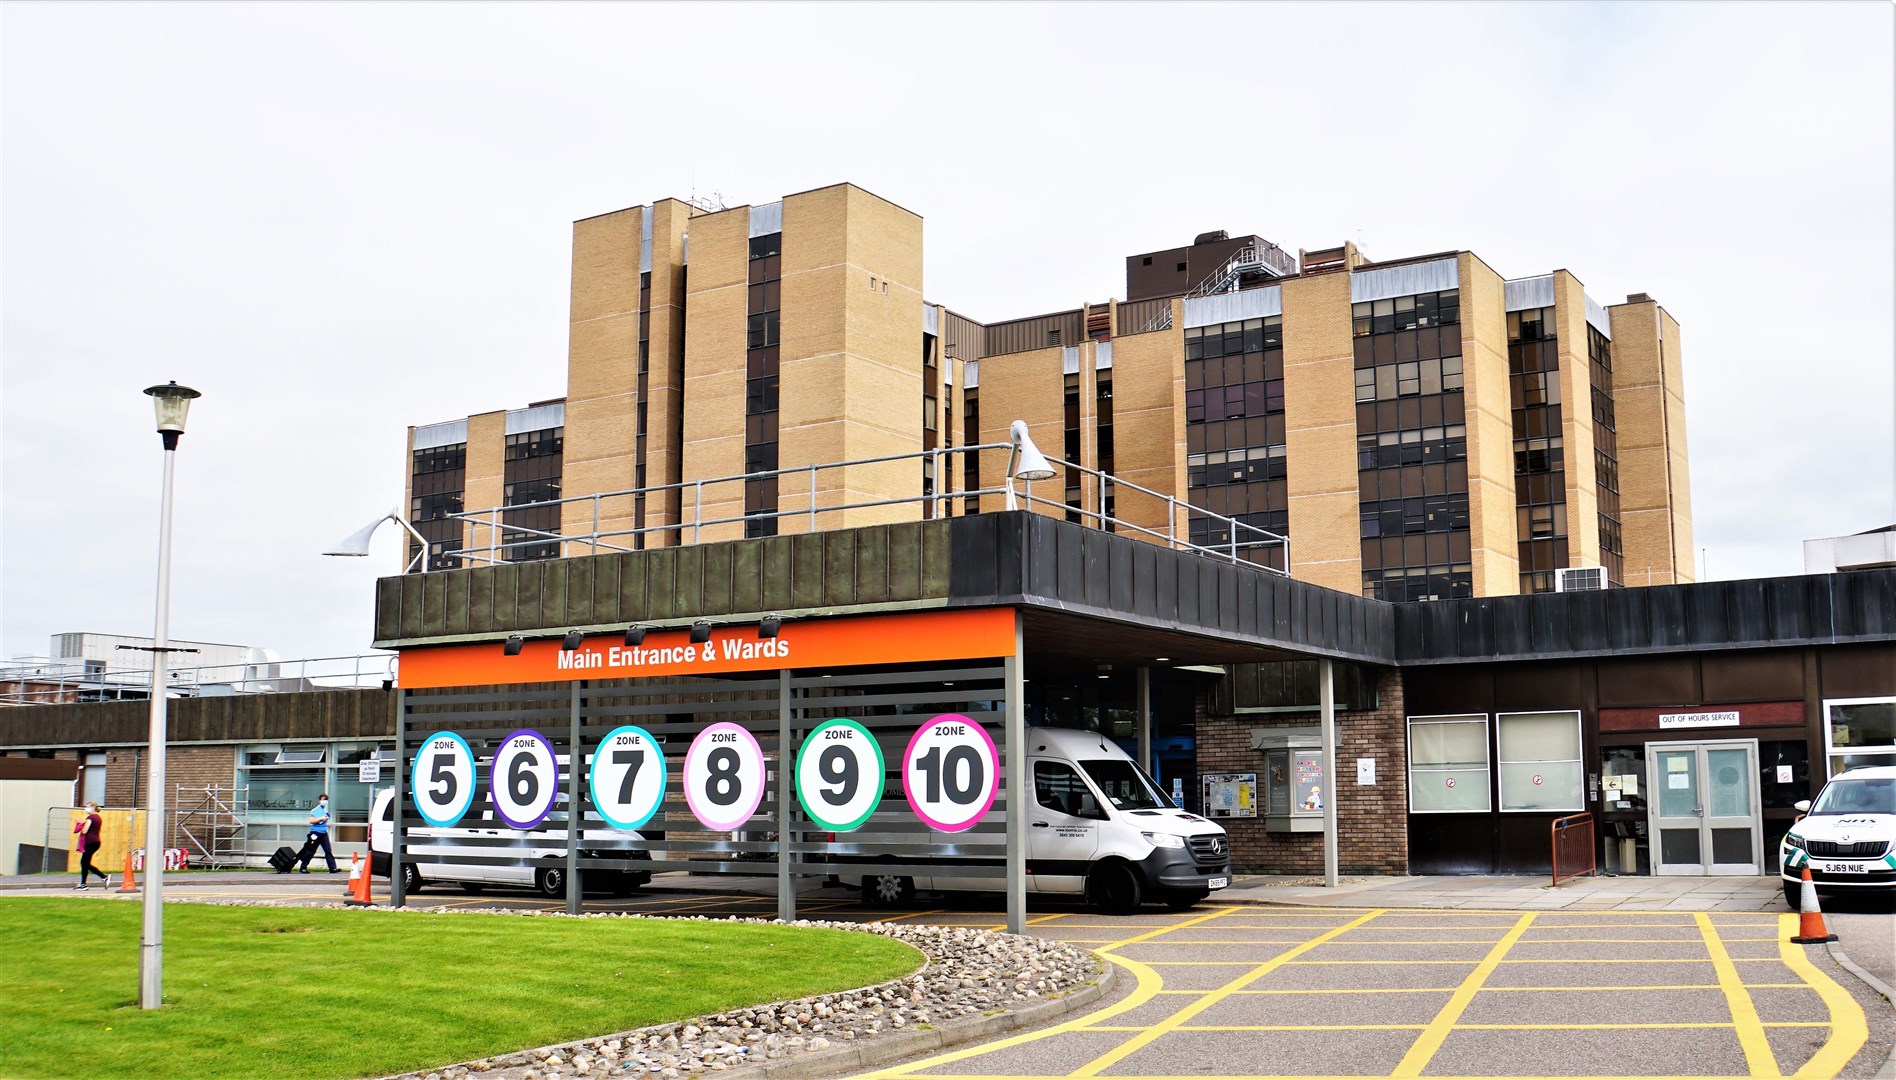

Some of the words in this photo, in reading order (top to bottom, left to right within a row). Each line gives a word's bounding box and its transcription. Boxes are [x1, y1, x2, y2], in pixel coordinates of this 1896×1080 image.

[557, 648, 602, 669] Main
[608, 645, 696, 667] Entrance
[701, 640, 716, 661] &
[722, 637, 790, 660] Wards
[1688, 714, 1710, 722] HOURS
[1711, 713, 1736, 721] SERVICE
[825, 730, 853, 739] ZONE
[935, 726, 965, 736] ZONE
[616, 736, 641, 745] ZONE
[711, 733, 737, 742] ZONE
[434, 741, 454, 749] ZONE
[513, 740, 536, 748] ZONE
[428, 754, 457, 805] 5
[507, 751, 539, 806] 6
[612, 750, 644, 804] 7
[705, 746, 742, 806] 8
[818, 744, 859, 806] 9
[916, 745, 984, 805] 10
[1825, 864, 1847, 872] SJ69
[1848, 864, 1865, 872] NUE
